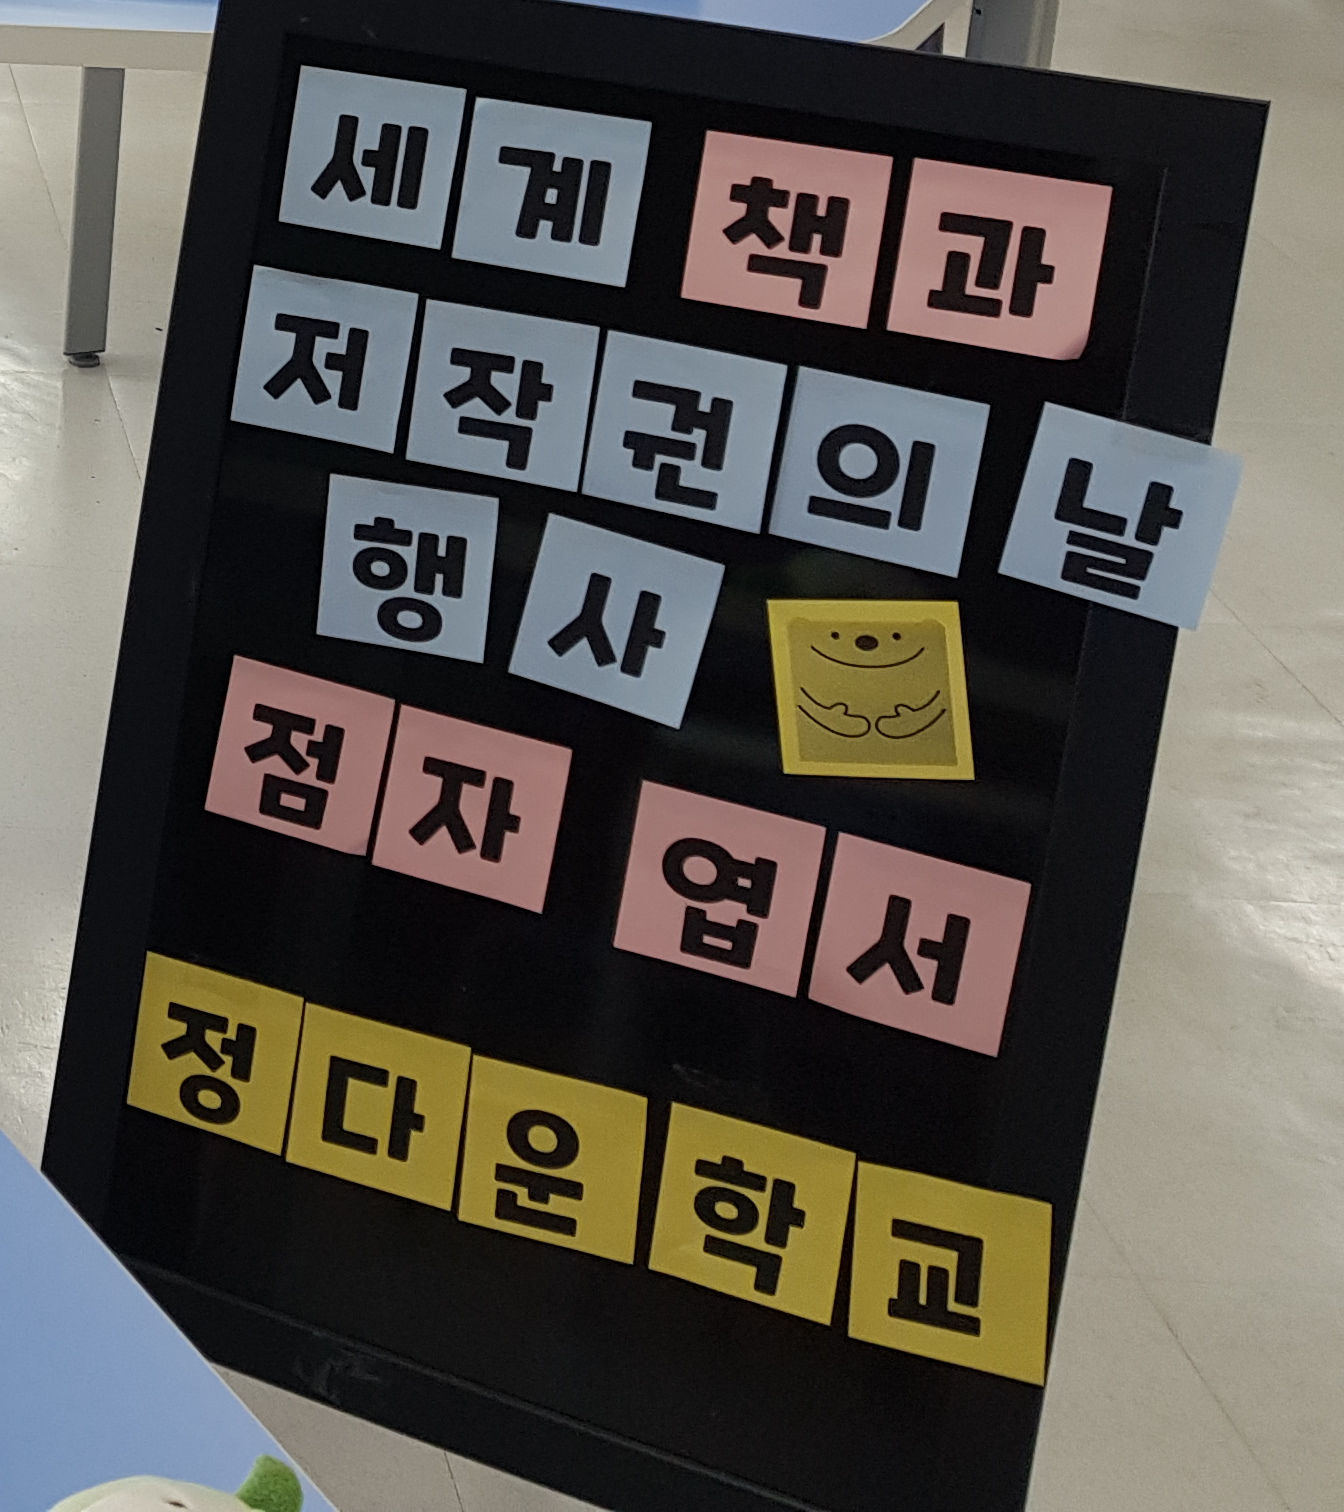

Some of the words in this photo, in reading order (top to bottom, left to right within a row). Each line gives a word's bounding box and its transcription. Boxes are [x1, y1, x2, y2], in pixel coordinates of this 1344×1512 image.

[310, 110, 612, 248] 세계
[721, 175, 1056, 323] 책과
[263, 312, 936, 532] 저작권의
[1050, 469, 1183, 601] 날
[352, 514, 667, 679] 행사
[243, 703, 522, 864] 점자
[658, 833, 972, 1007] 엽서
